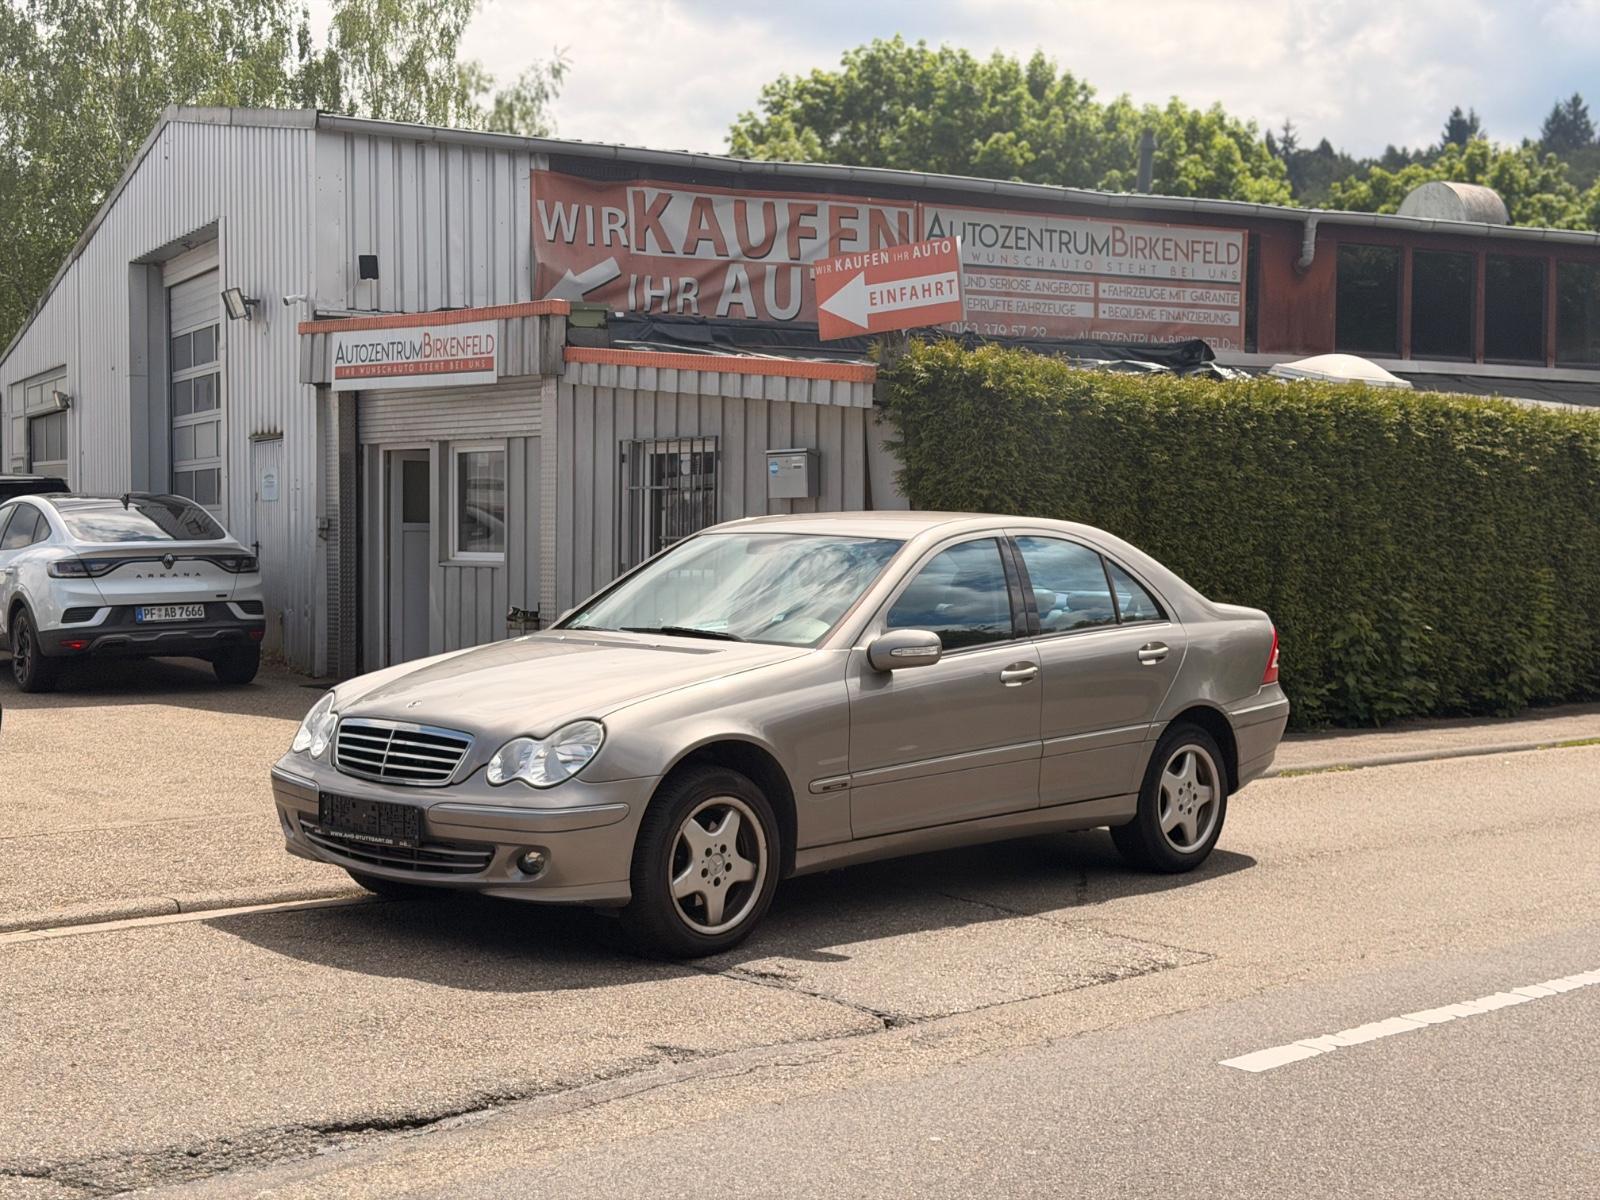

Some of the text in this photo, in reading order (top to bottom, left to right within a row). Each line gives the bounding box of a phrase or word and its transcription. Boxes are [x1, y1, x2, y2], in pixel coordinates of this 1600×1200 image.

[537, 190, 910, 260] WIR KAUFEN
[815, 240, 951, 276] WIR KAUFEN IHR AUTO
[971, 252, 1238, 281] WUNSCHAUTO STEHT BEI UNS
[628, 263, 815, 321] IHR AU
[869, 279, 955, 307] EINFAHRT
[1035, 281, 1091, 296] ANGEBOTE
[1107, 285, 1239, 305] FAHRZEUGE MIT GARANTIE
[1016, 301, 1076, 316] FAHRZEUGE
[1107, 306, 1232, 324] BEQUEME FINANZIERUNG
[359, 363, 415, 375] WUNSCHAUTO
[419, 361, 445, 372] STEHT
[469, 359, 487, 369] UNS
[143, 604, 204, 619] PF AB 7666
